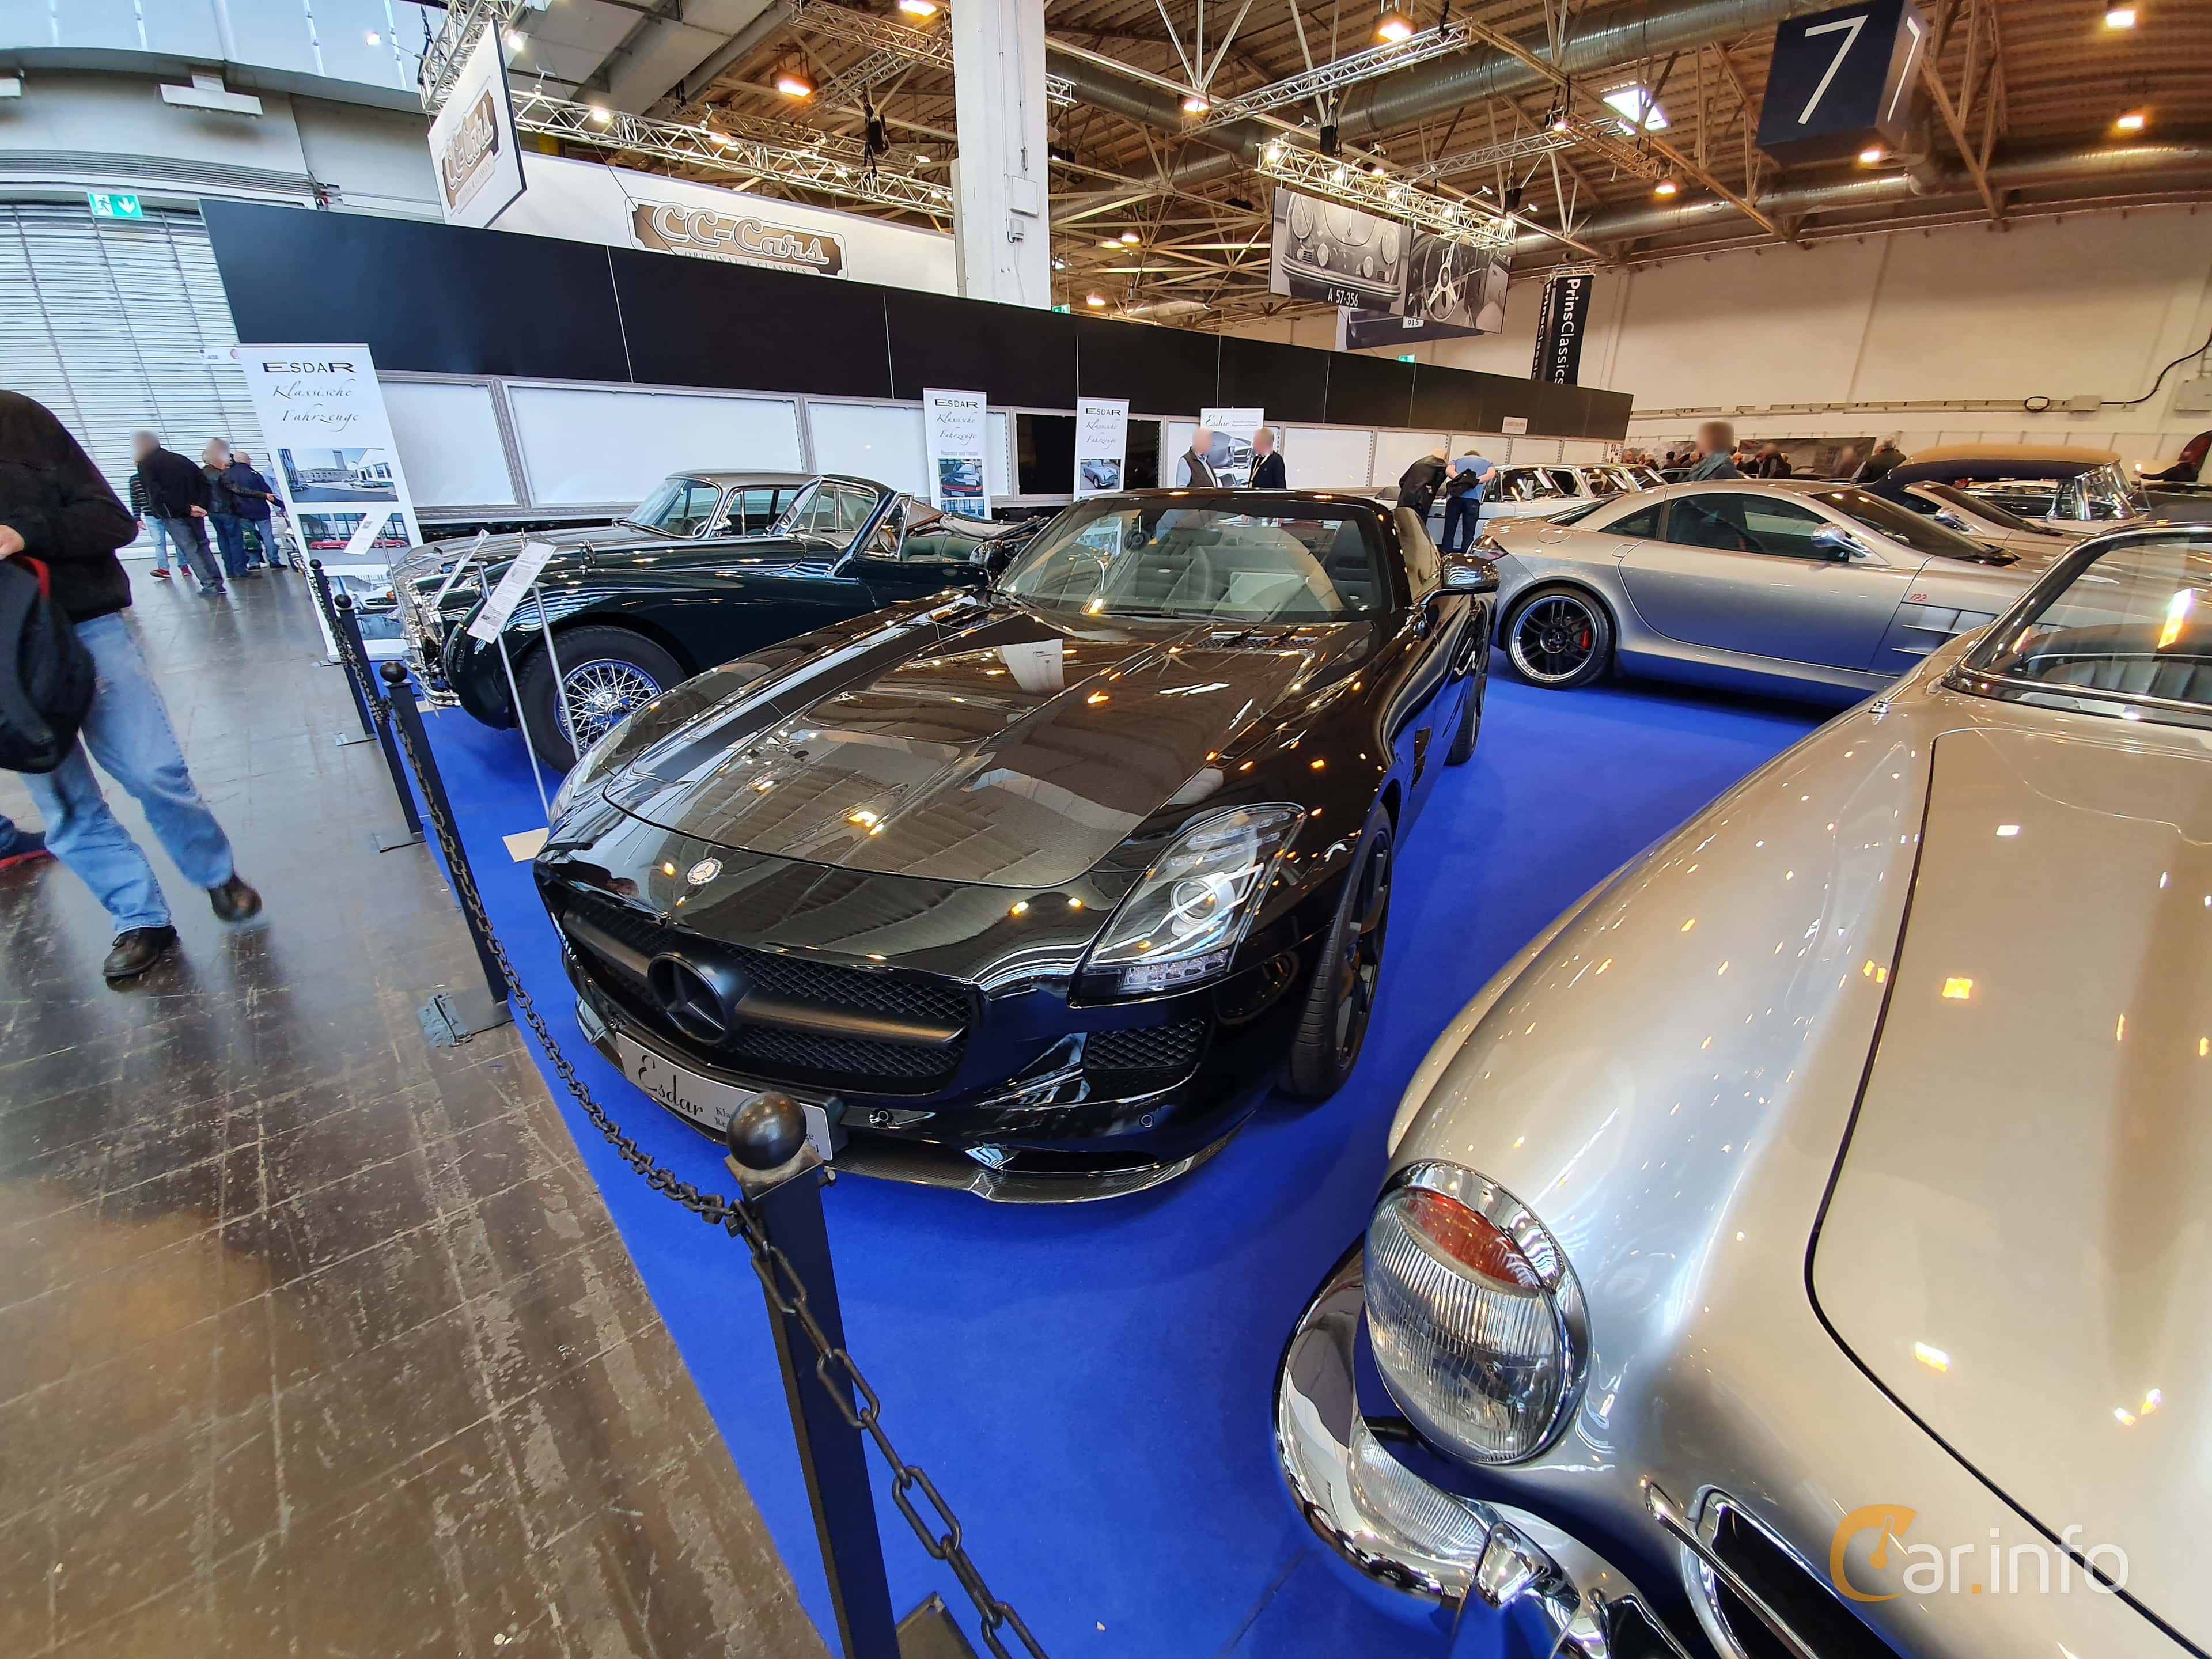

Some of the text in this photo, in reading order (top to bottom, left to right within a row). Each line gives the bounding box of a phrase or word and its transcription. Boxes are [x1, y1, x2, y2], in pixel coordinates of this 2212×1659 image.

[1798, 14, 1869, 125] 7
[652, 202, 830, 265] CC-Cars
[1328, 287, 1333, 302] A
[1554, 278, 1581, 384] PrinsClassics
[262, 362, 357, 373] ESDAR
[272, 378, 356, 399] Klassische
[934, 398, 979, 408] ESDAR
[1085, 408, 1122, 416] ESDAR
[282, 403, 359, 433] Fahrzeuge
[1910, 593, 1927, 602] 722
[638, 1055, 704, 1117] Esdar
